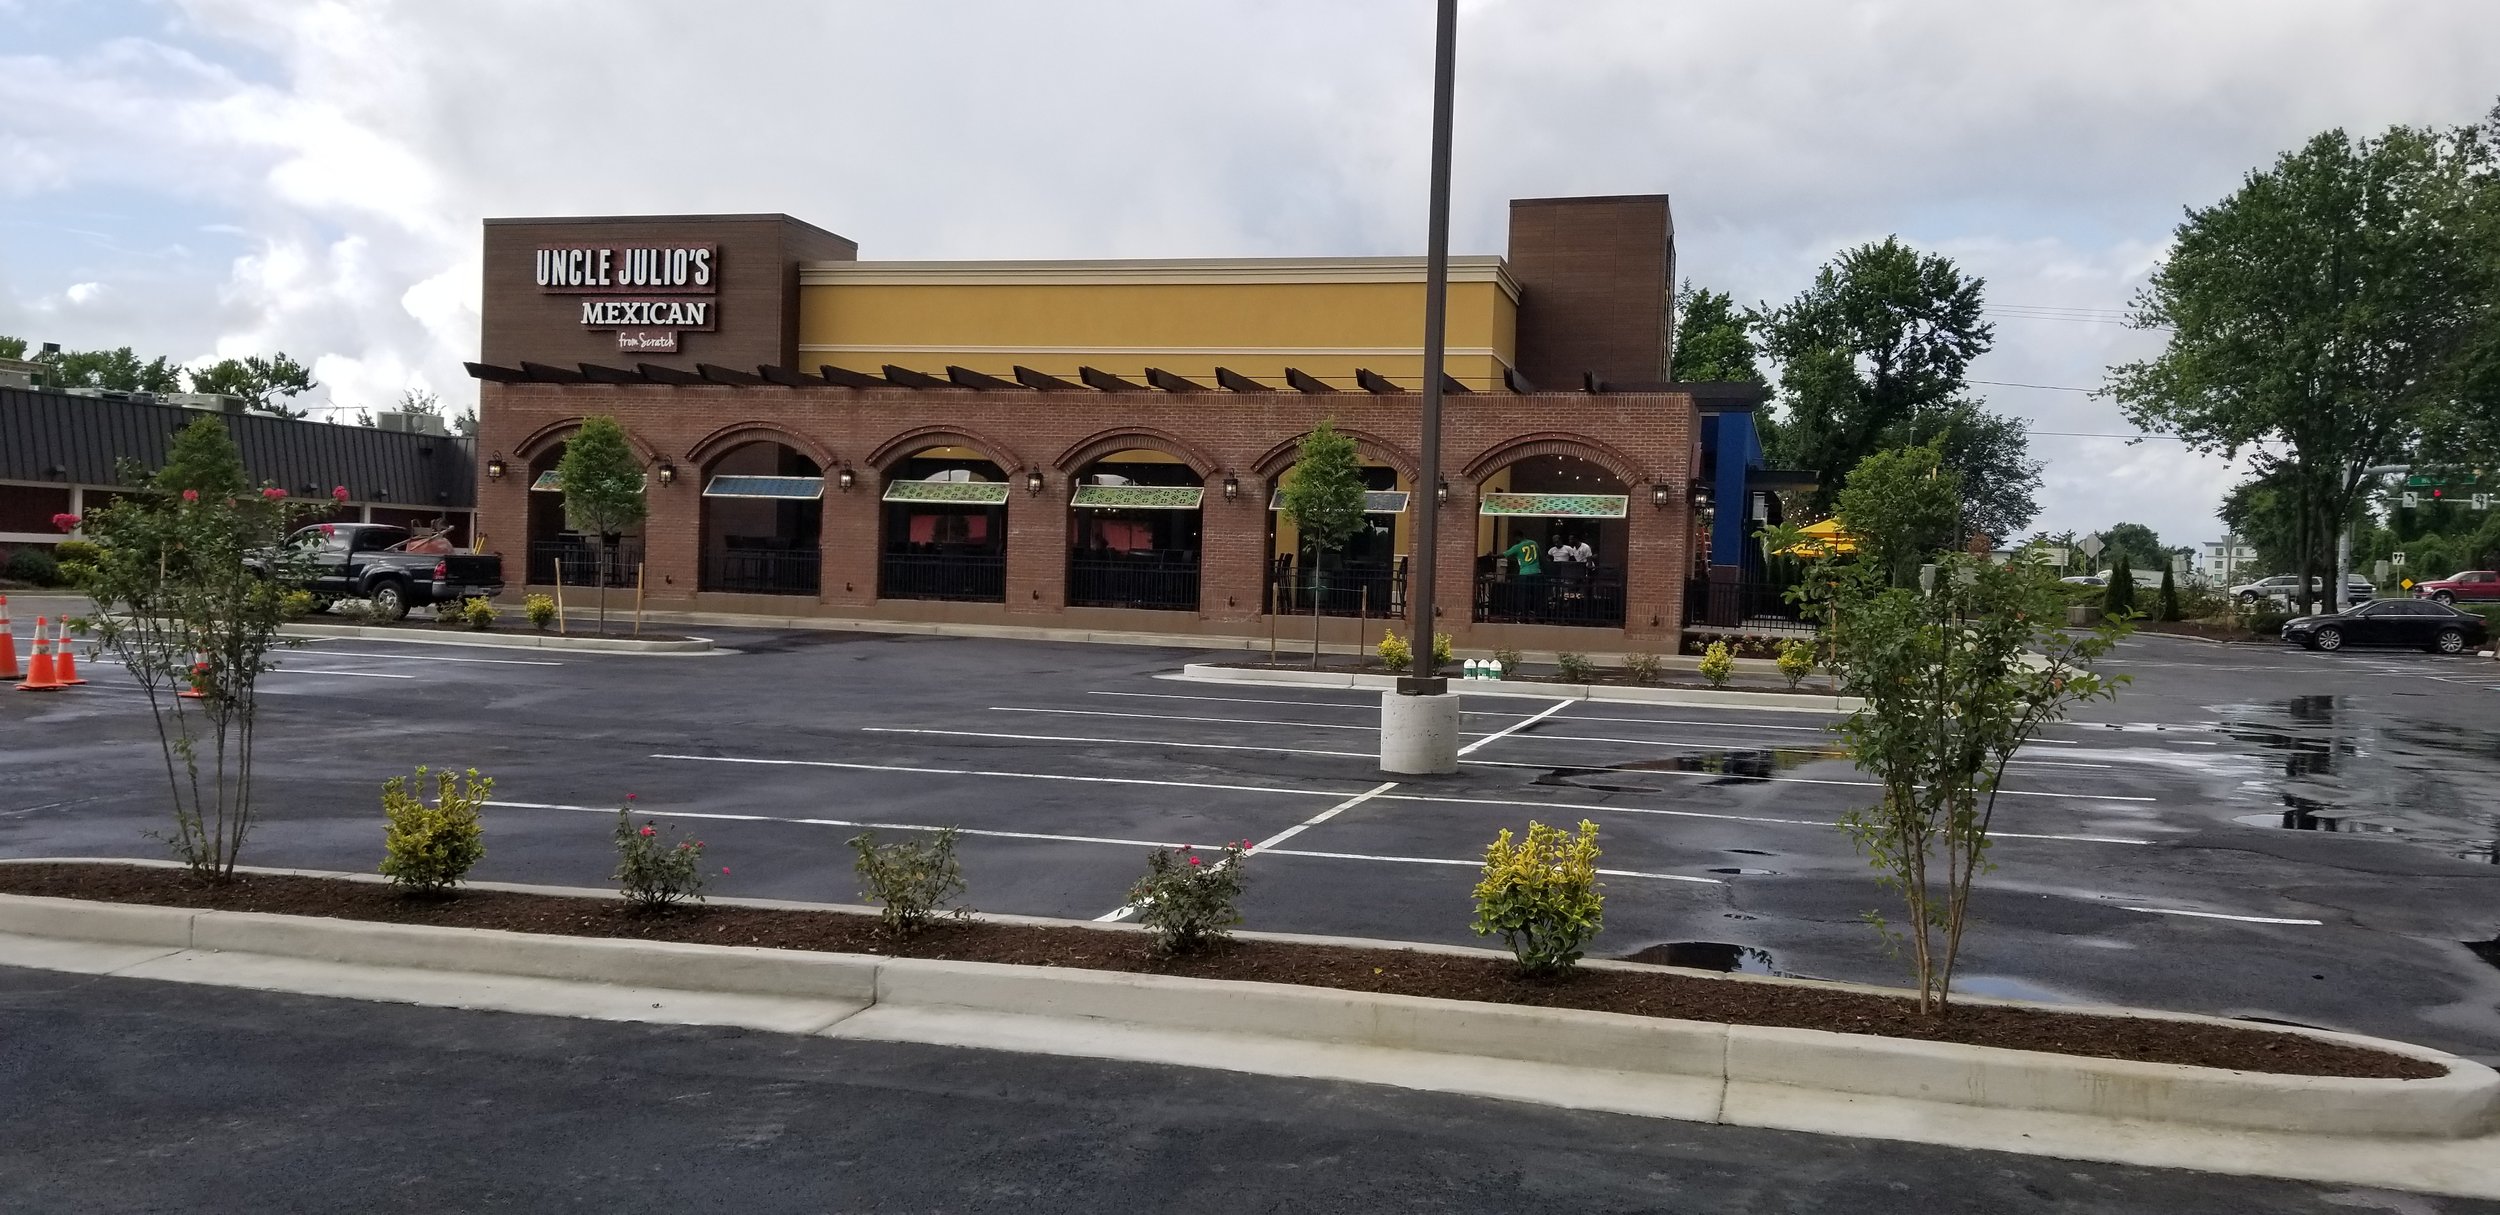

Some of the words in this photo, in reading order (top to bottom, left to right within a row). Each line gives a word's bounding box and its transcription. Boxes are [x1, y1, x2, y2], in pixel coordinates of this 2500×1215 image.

[537, 249, 611, 286] UNCLE
[618, 248, 710, 286] JULIO'S
[580, 302, 706, 325] MEXICAN
[618, 332, 639, 348] from
[638, 332, 675, 348] Scratch
